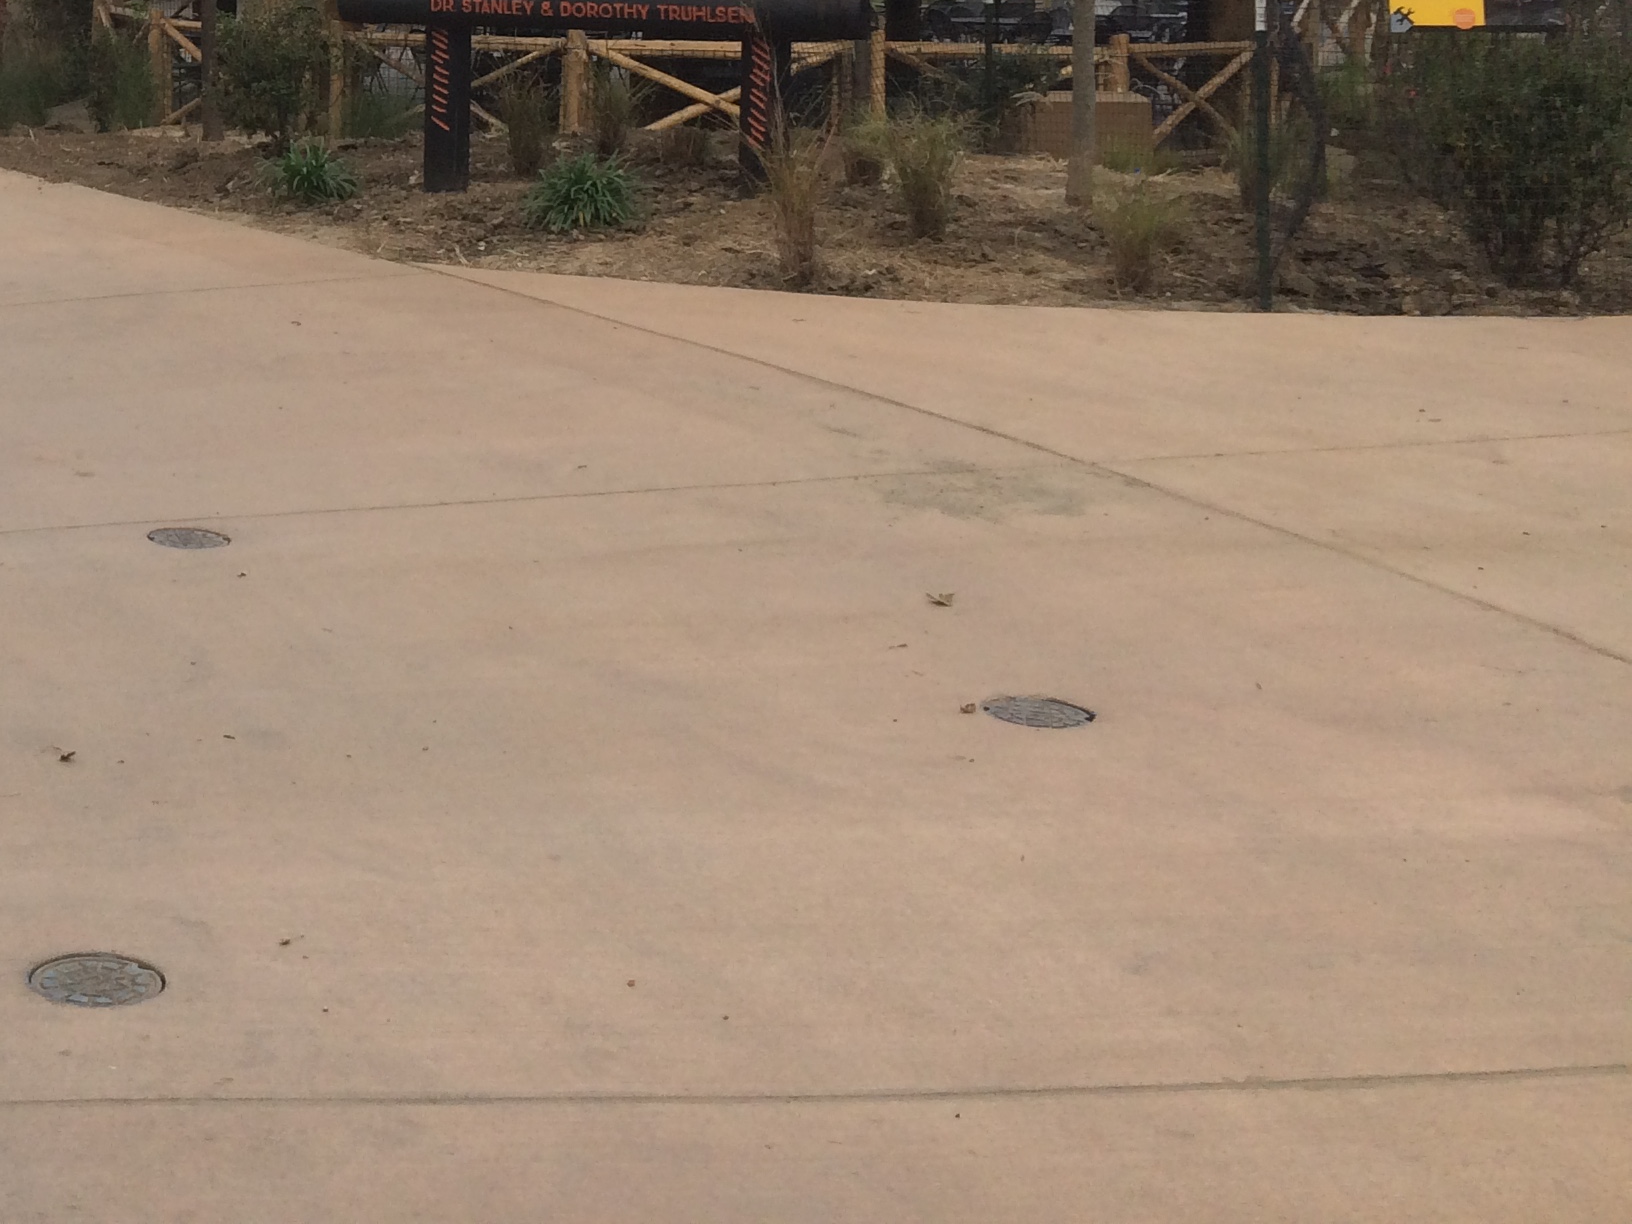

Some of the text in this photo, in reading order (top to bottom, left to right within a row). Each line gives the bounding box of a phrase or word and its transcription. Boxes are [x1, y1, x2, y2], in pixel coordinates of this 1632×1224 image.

[540, 0, 554, 17] &
[559, 0, 650, 21] DOROTHY
[656, 4, 756, 24] TRUHLSEN
